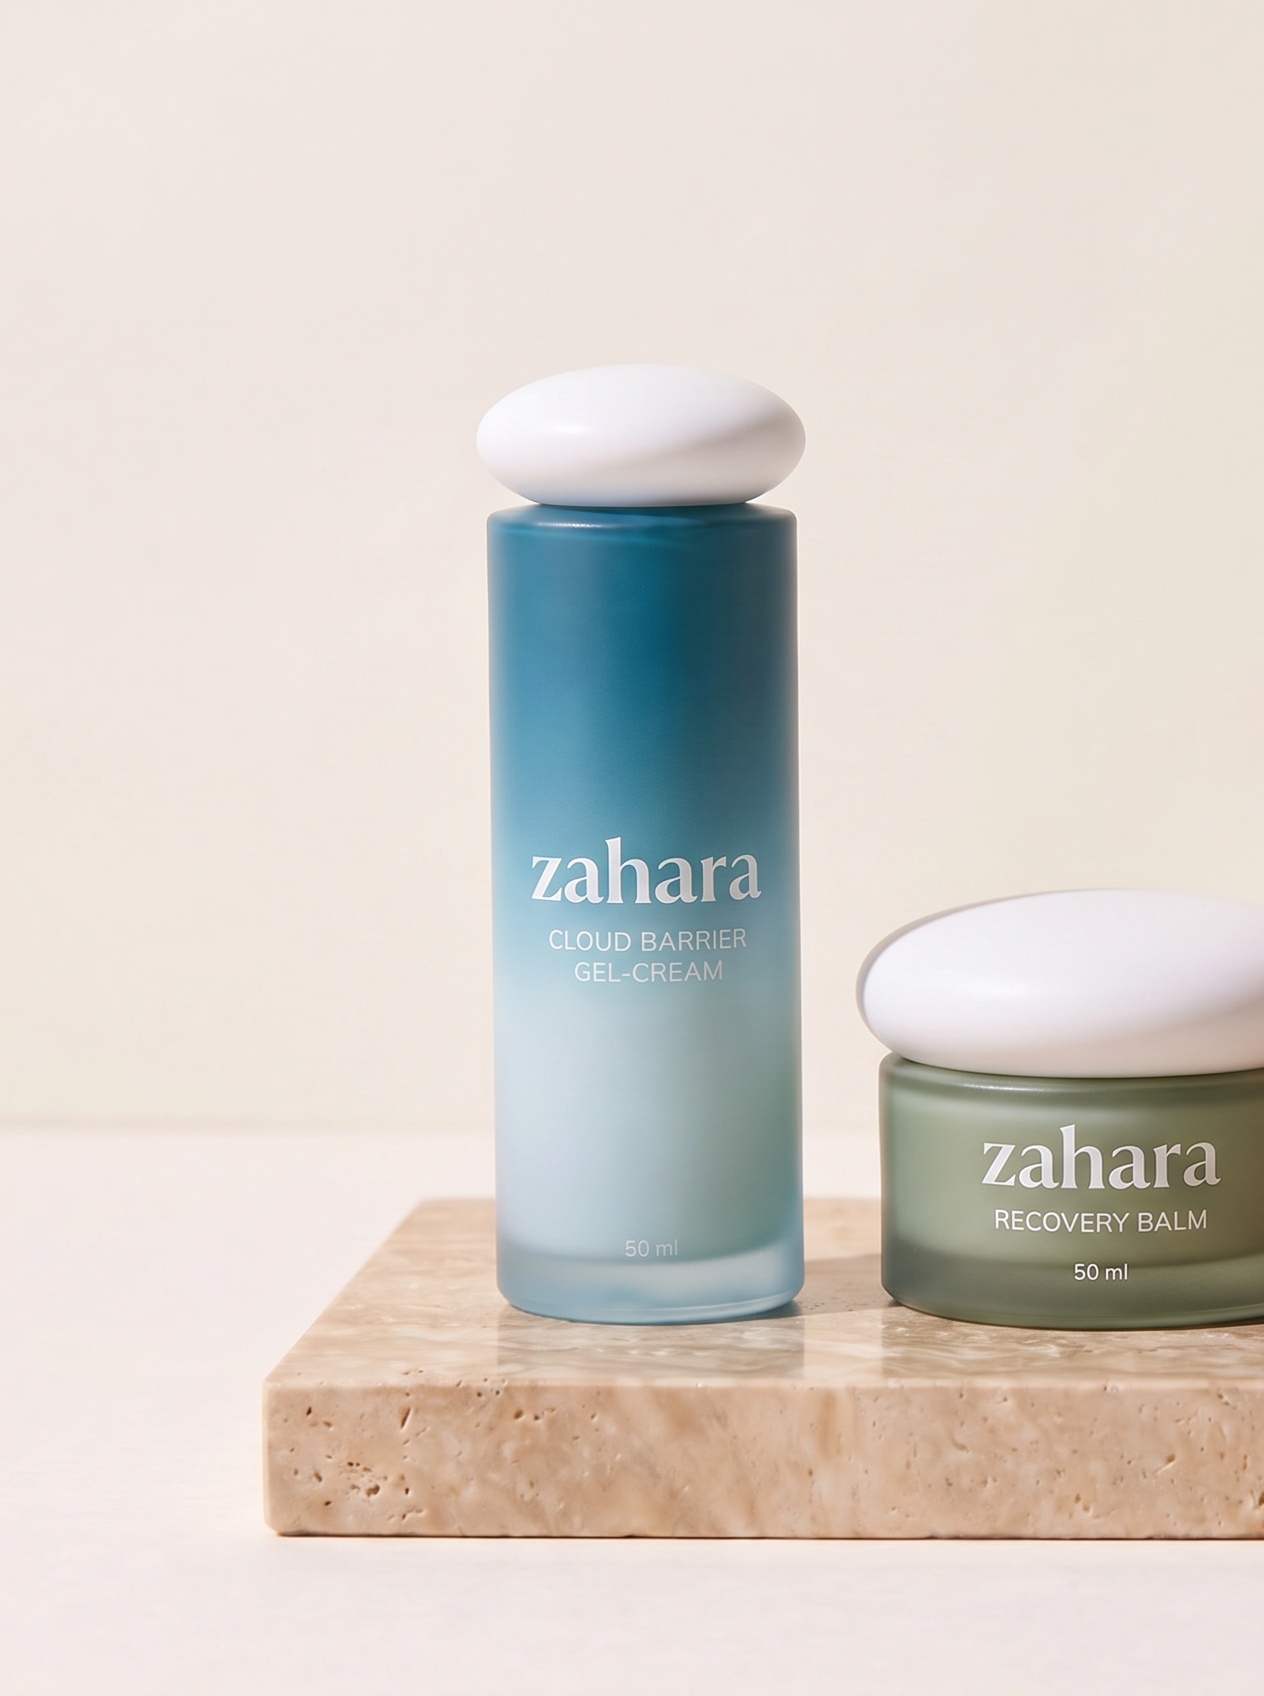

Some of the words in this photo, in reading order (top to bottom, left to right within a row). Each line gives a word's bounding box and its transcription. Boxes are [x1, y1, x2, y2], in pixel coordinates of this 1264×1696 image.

[531, 837, 762, 904] zahara
[549, 929, 632, 952] CLOUD
[641, 928, 748, 952] BARRIER
[574, 960, 724, 983] GEL-CREAM
[981, 1124, 1222, 1190] zahara
[994, 1209, 1131, 1233] RECOVERY
[1138, 1209, 1208, 1233] BALM
[624, 1239, 651, 1258] 50
[656, 1239, 678, 1257] ml
[1073, 1263, 1100, 1281] 50
[1105, 1263, 1129, 1281] ml
